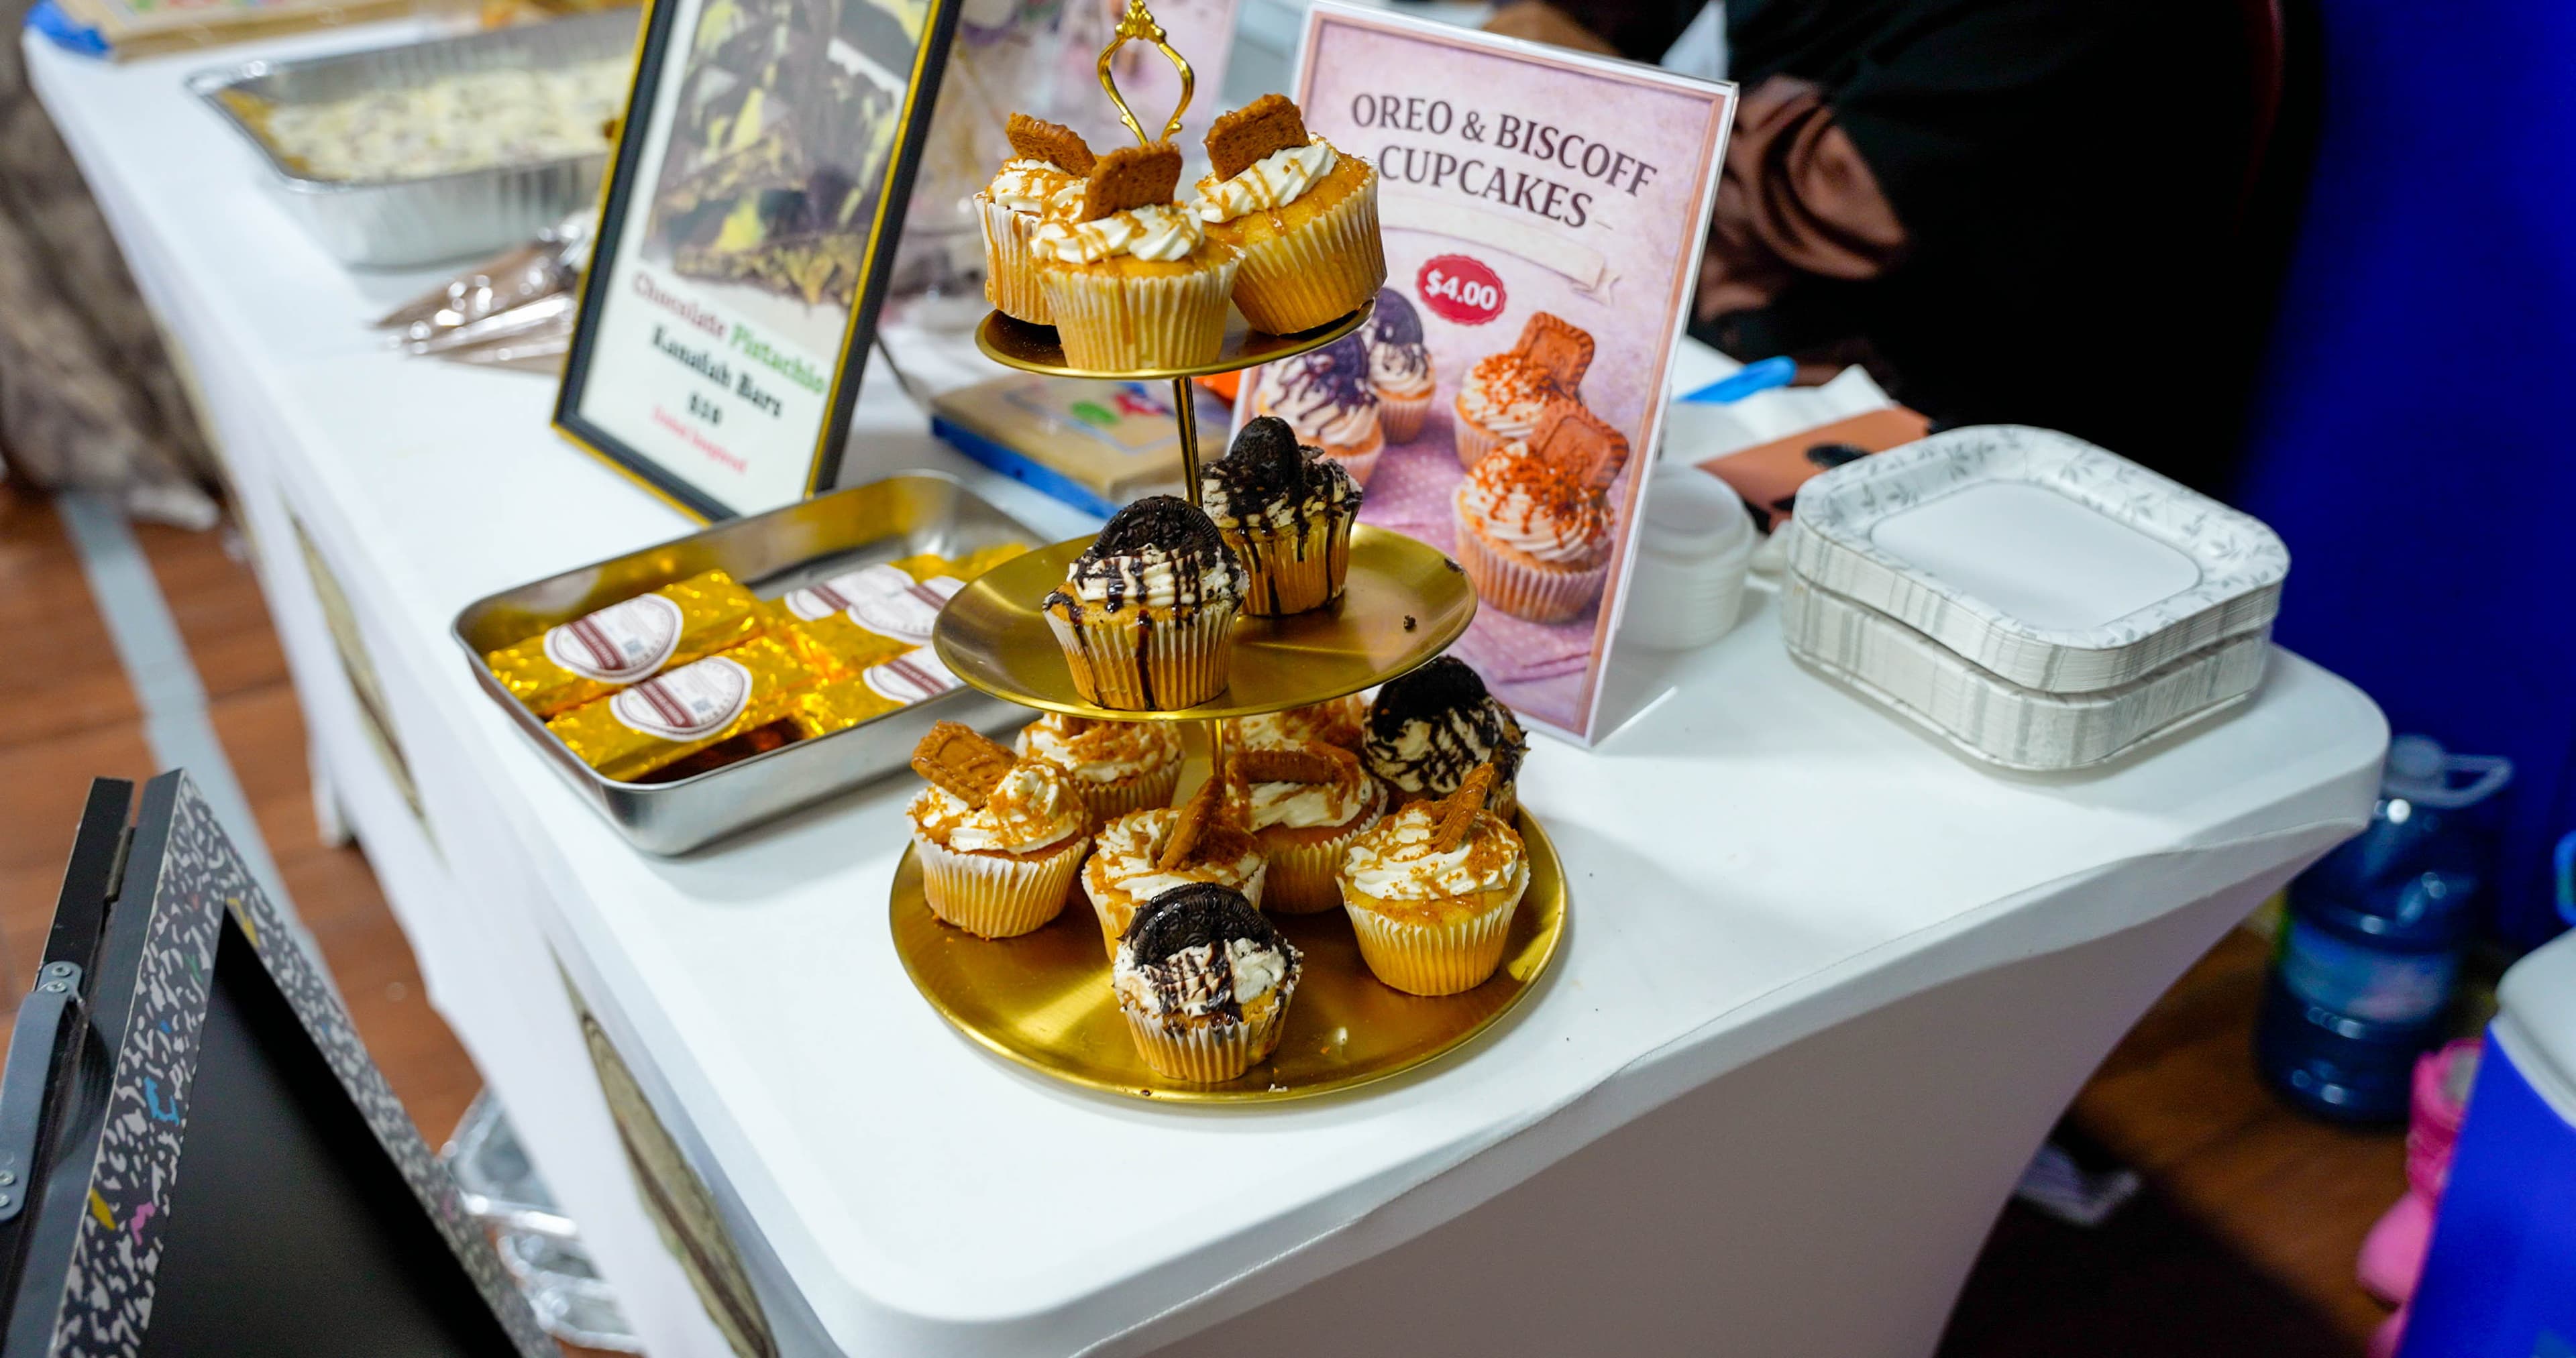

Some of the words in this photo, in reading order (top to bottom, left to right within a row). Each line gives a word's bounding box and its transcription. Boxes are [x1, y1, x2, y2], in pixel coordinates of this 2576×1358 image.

[1351, 93, 1453, 134] OREO
[1460, 111, 1487, 142] &
[1493, 113, 1658, 196] BISCOFF
[1378, 145, 1594, 228] CUPCAKES
[1424, 268, 1498, 311] $4.00
[633, 271, 727, 339] Chocolate
[729, 322, 825, 396] Pistachio
[736, 371, 782, 418] Bars
